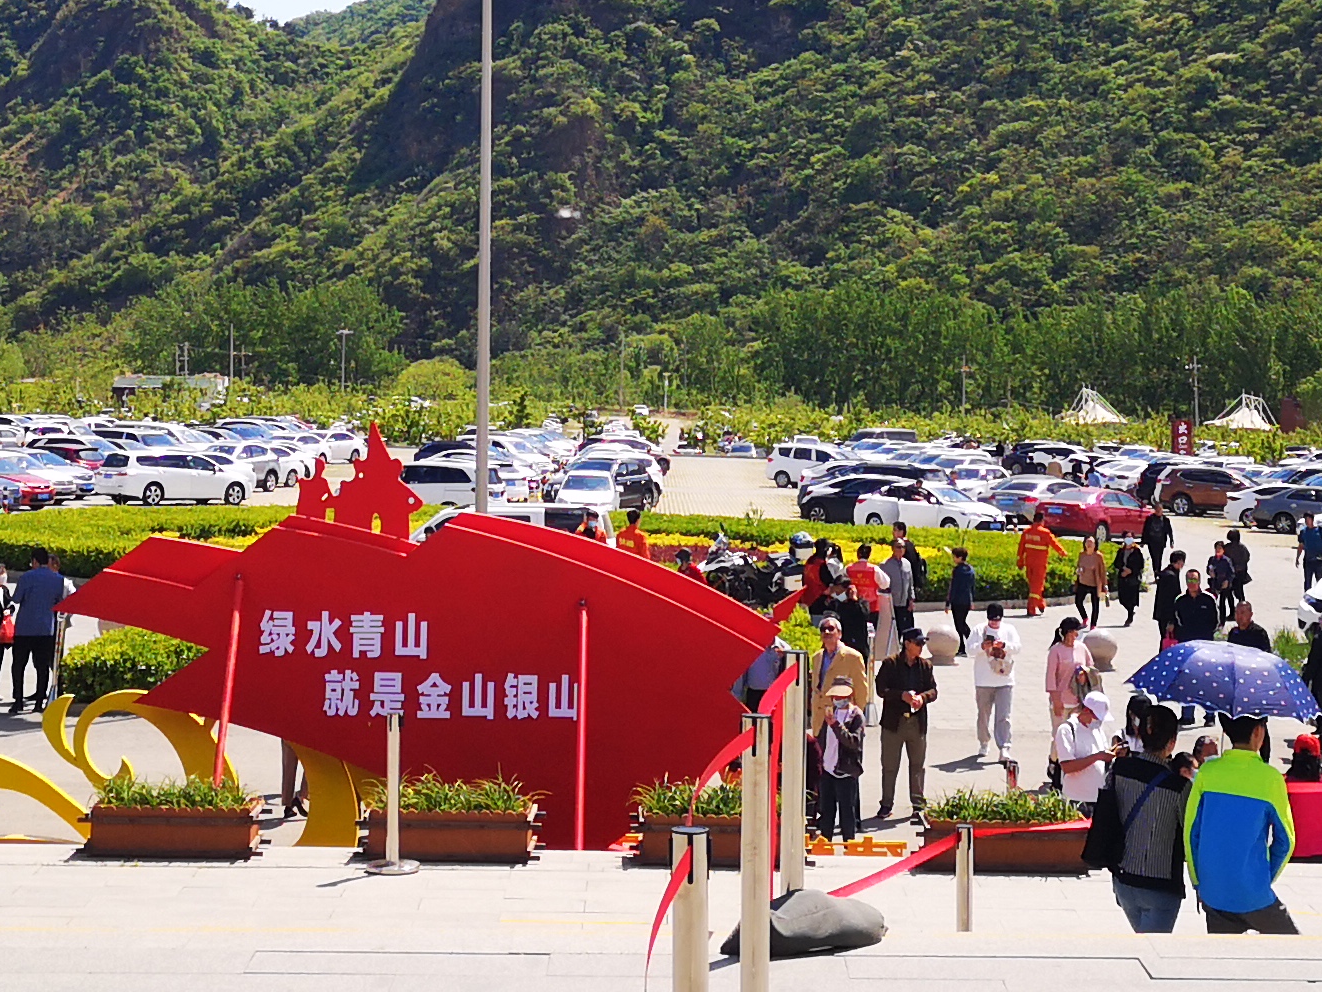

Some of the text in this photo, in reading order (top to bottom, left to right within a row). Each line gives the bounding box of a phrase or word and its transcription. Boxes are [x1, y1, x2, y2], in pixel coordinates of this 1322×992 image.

[259, 610, 428, 659] 绿水青山
[323, 669, 578, 721] 就是金山银山
